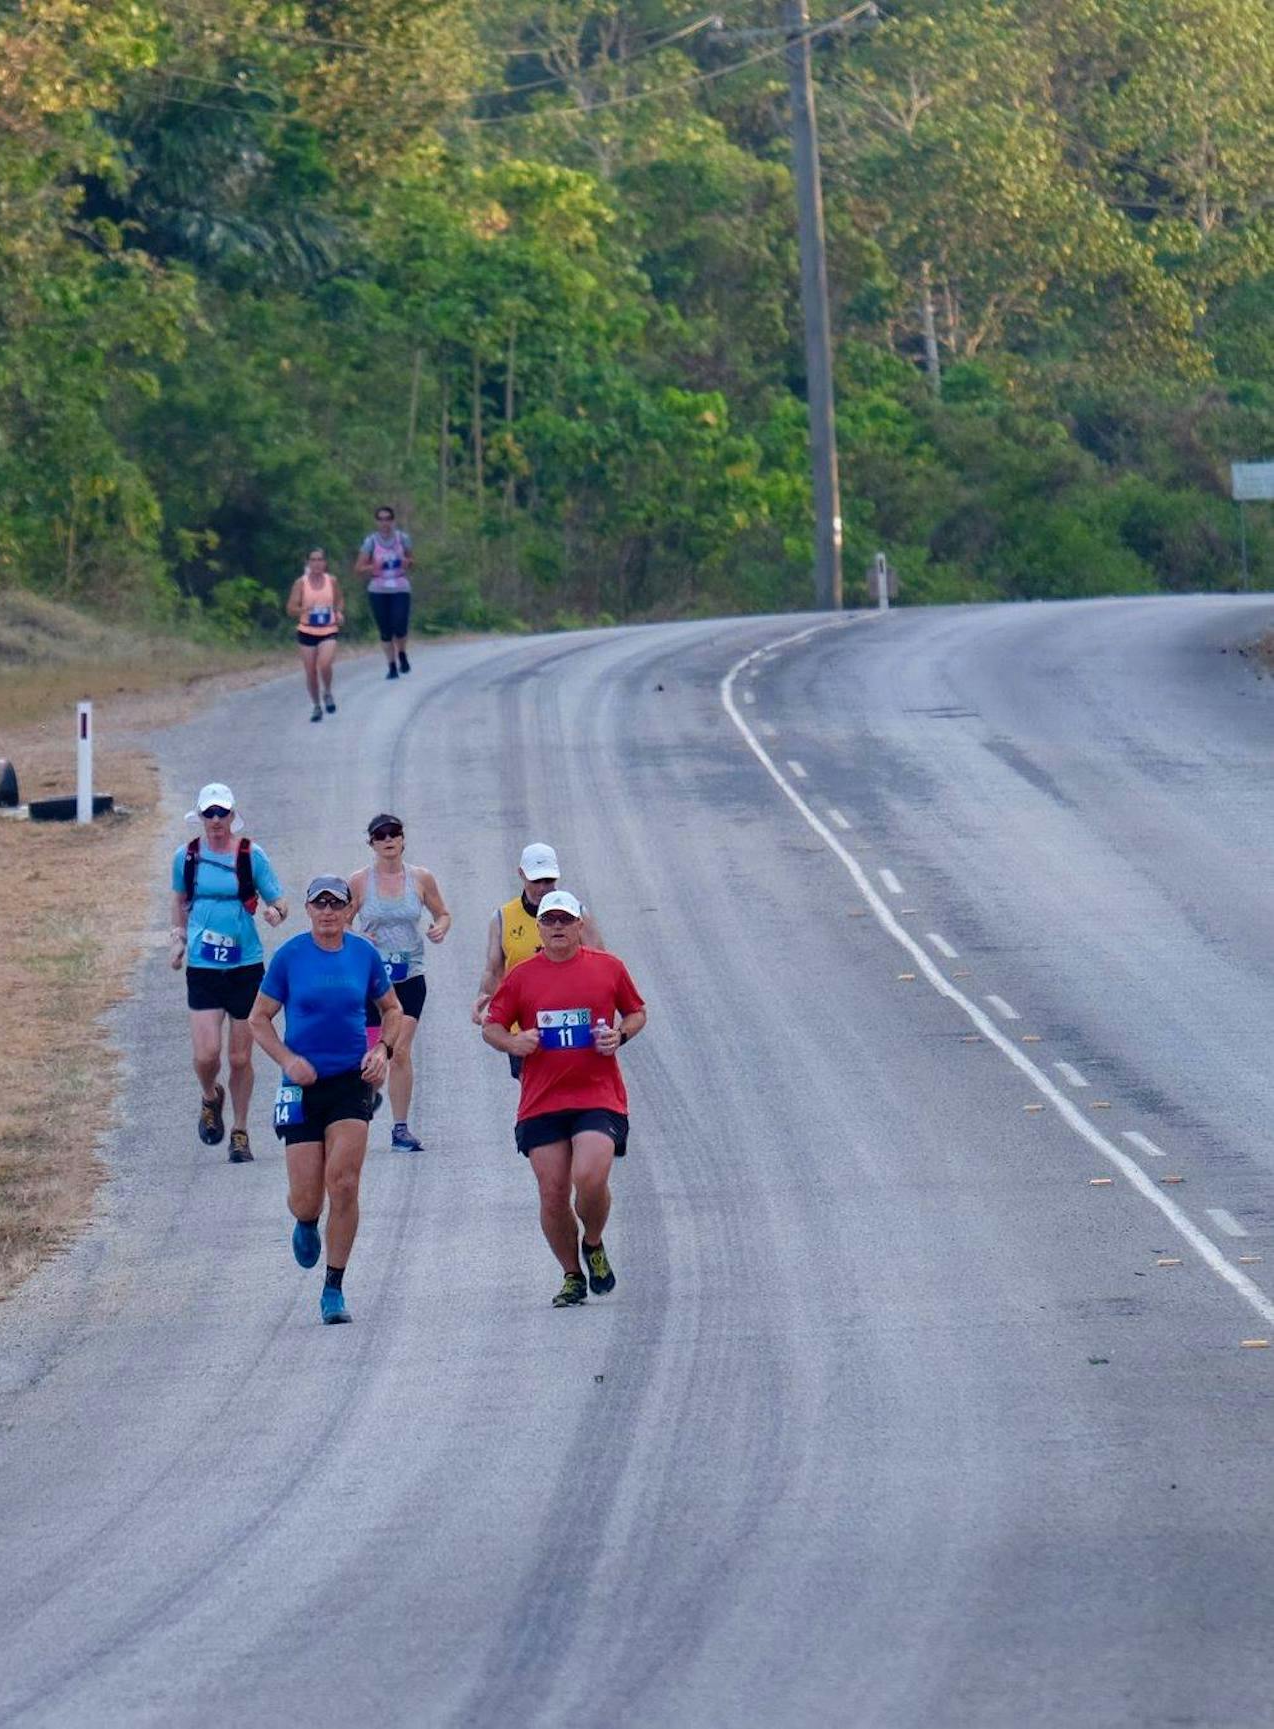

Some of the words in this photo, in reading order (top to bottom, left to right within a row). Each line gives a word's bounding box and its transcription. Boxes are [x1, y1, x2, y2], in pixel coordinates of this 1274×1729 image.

[214, 947, 228, 962] 12
[558, 1028, 573, 1046] 11
[276, 1104, 289, 1123] 14
